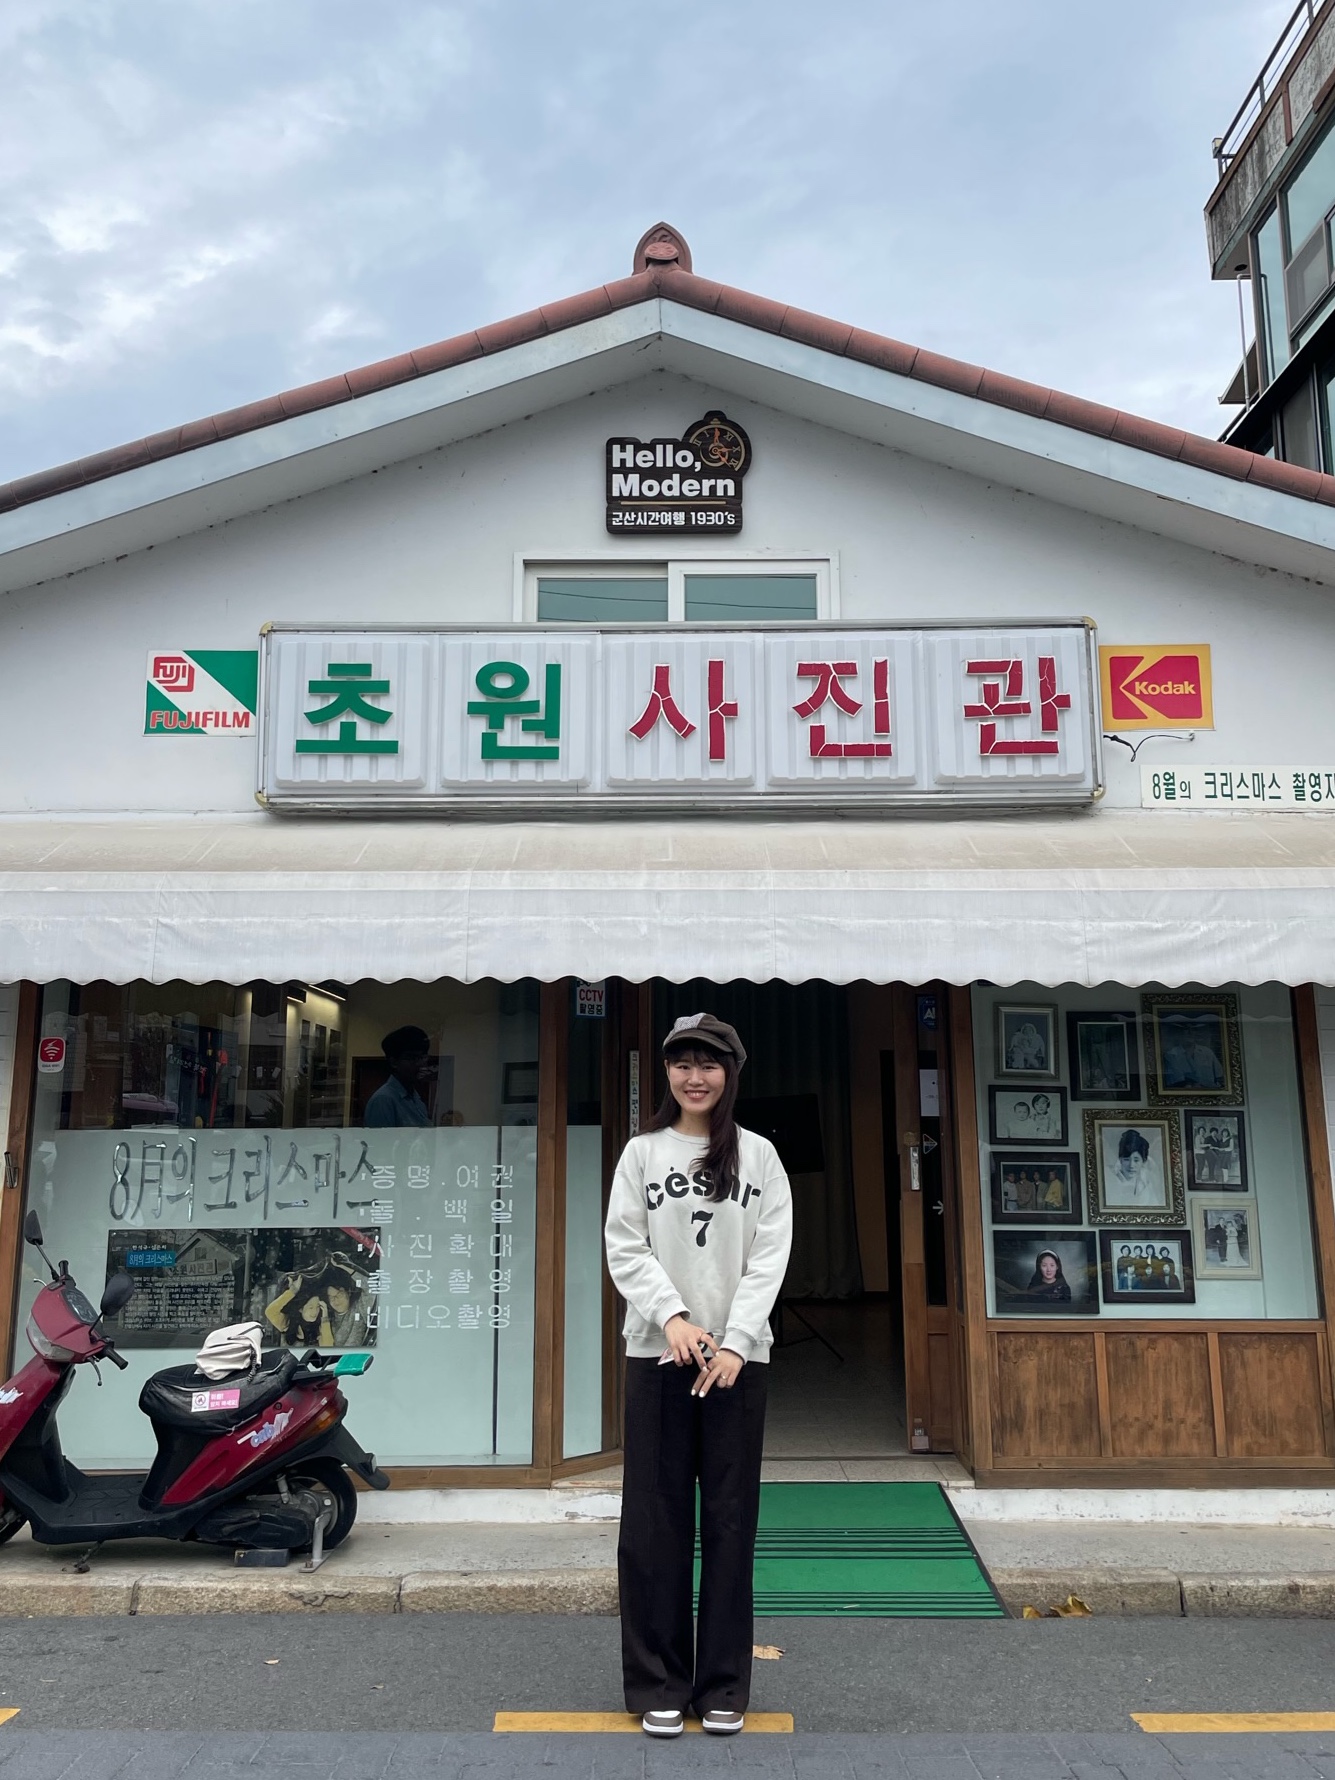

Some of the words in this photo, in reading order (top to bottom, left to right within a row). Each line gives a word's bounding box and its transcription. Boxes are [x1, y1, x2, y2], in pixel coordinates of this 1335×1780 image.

[611, 444, 702, 472] Hello,
[611, 473, 736, 497] Modern
[611, 511, 685, 526] 군산시간여행
[690, 511, 736, 526] 1930's
[1134, 681, 1197, 695] Kodak
[149, 710, 251, 729] FUJIFILM
[1152, 772, 1192, 801] 8월의
[1204, 772, 1282, 801] 크리스마스
[579, 988, 604, 1002] CCTV
[691, 1210, 714, 1248] 7
